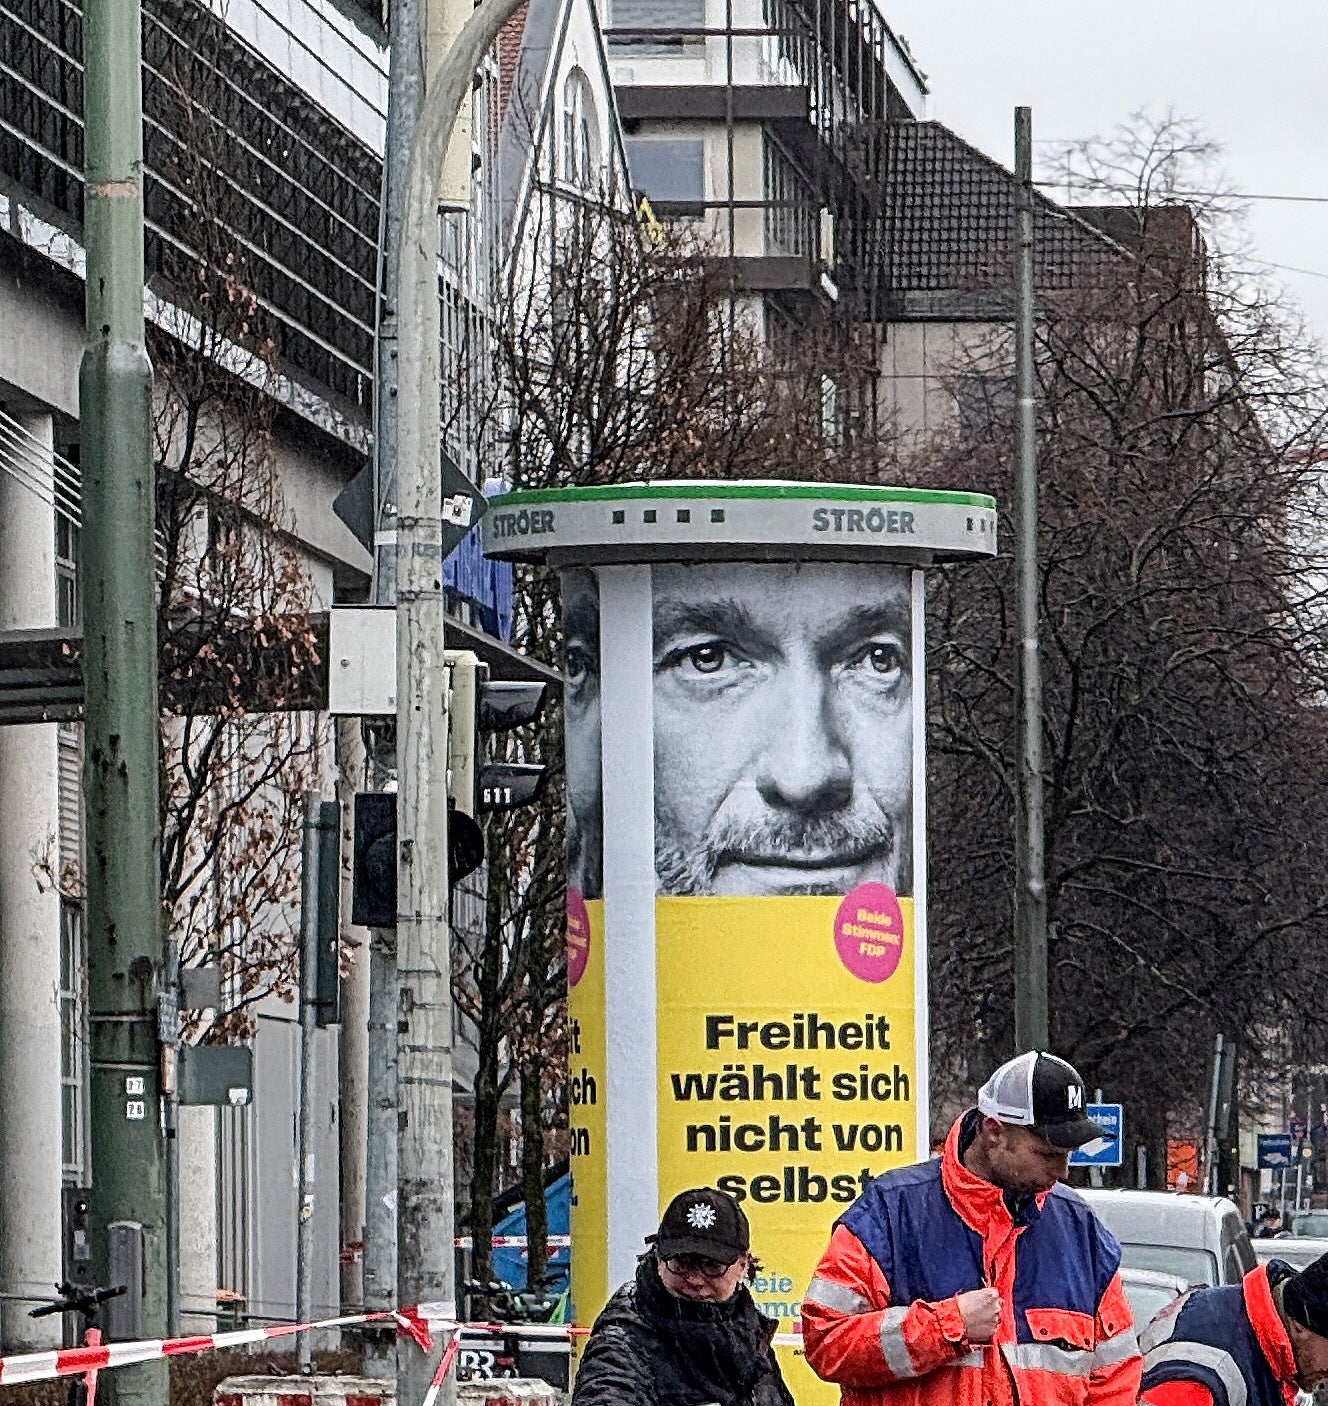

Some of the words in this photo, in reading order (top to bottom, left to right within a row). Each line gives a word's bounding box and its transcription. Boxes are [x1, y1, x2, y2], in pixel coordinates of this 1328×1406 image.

[493, 508, 556, 539] STRÖER
[812, 508, 915, 535] STRÖER
[856, 909, 892, 926] Beide
[859, 942, 887, 959] FDP
[705, 1013, 891, 1051] Freiheit
[671, 1064, 822, 1102] wählt
[831, 1064, 911, 1102] sich
[686, 1115, 823, 1152] nicht
[832, 1122, 904, 1153] von
[716, 1166, 873, 1204] selbst
